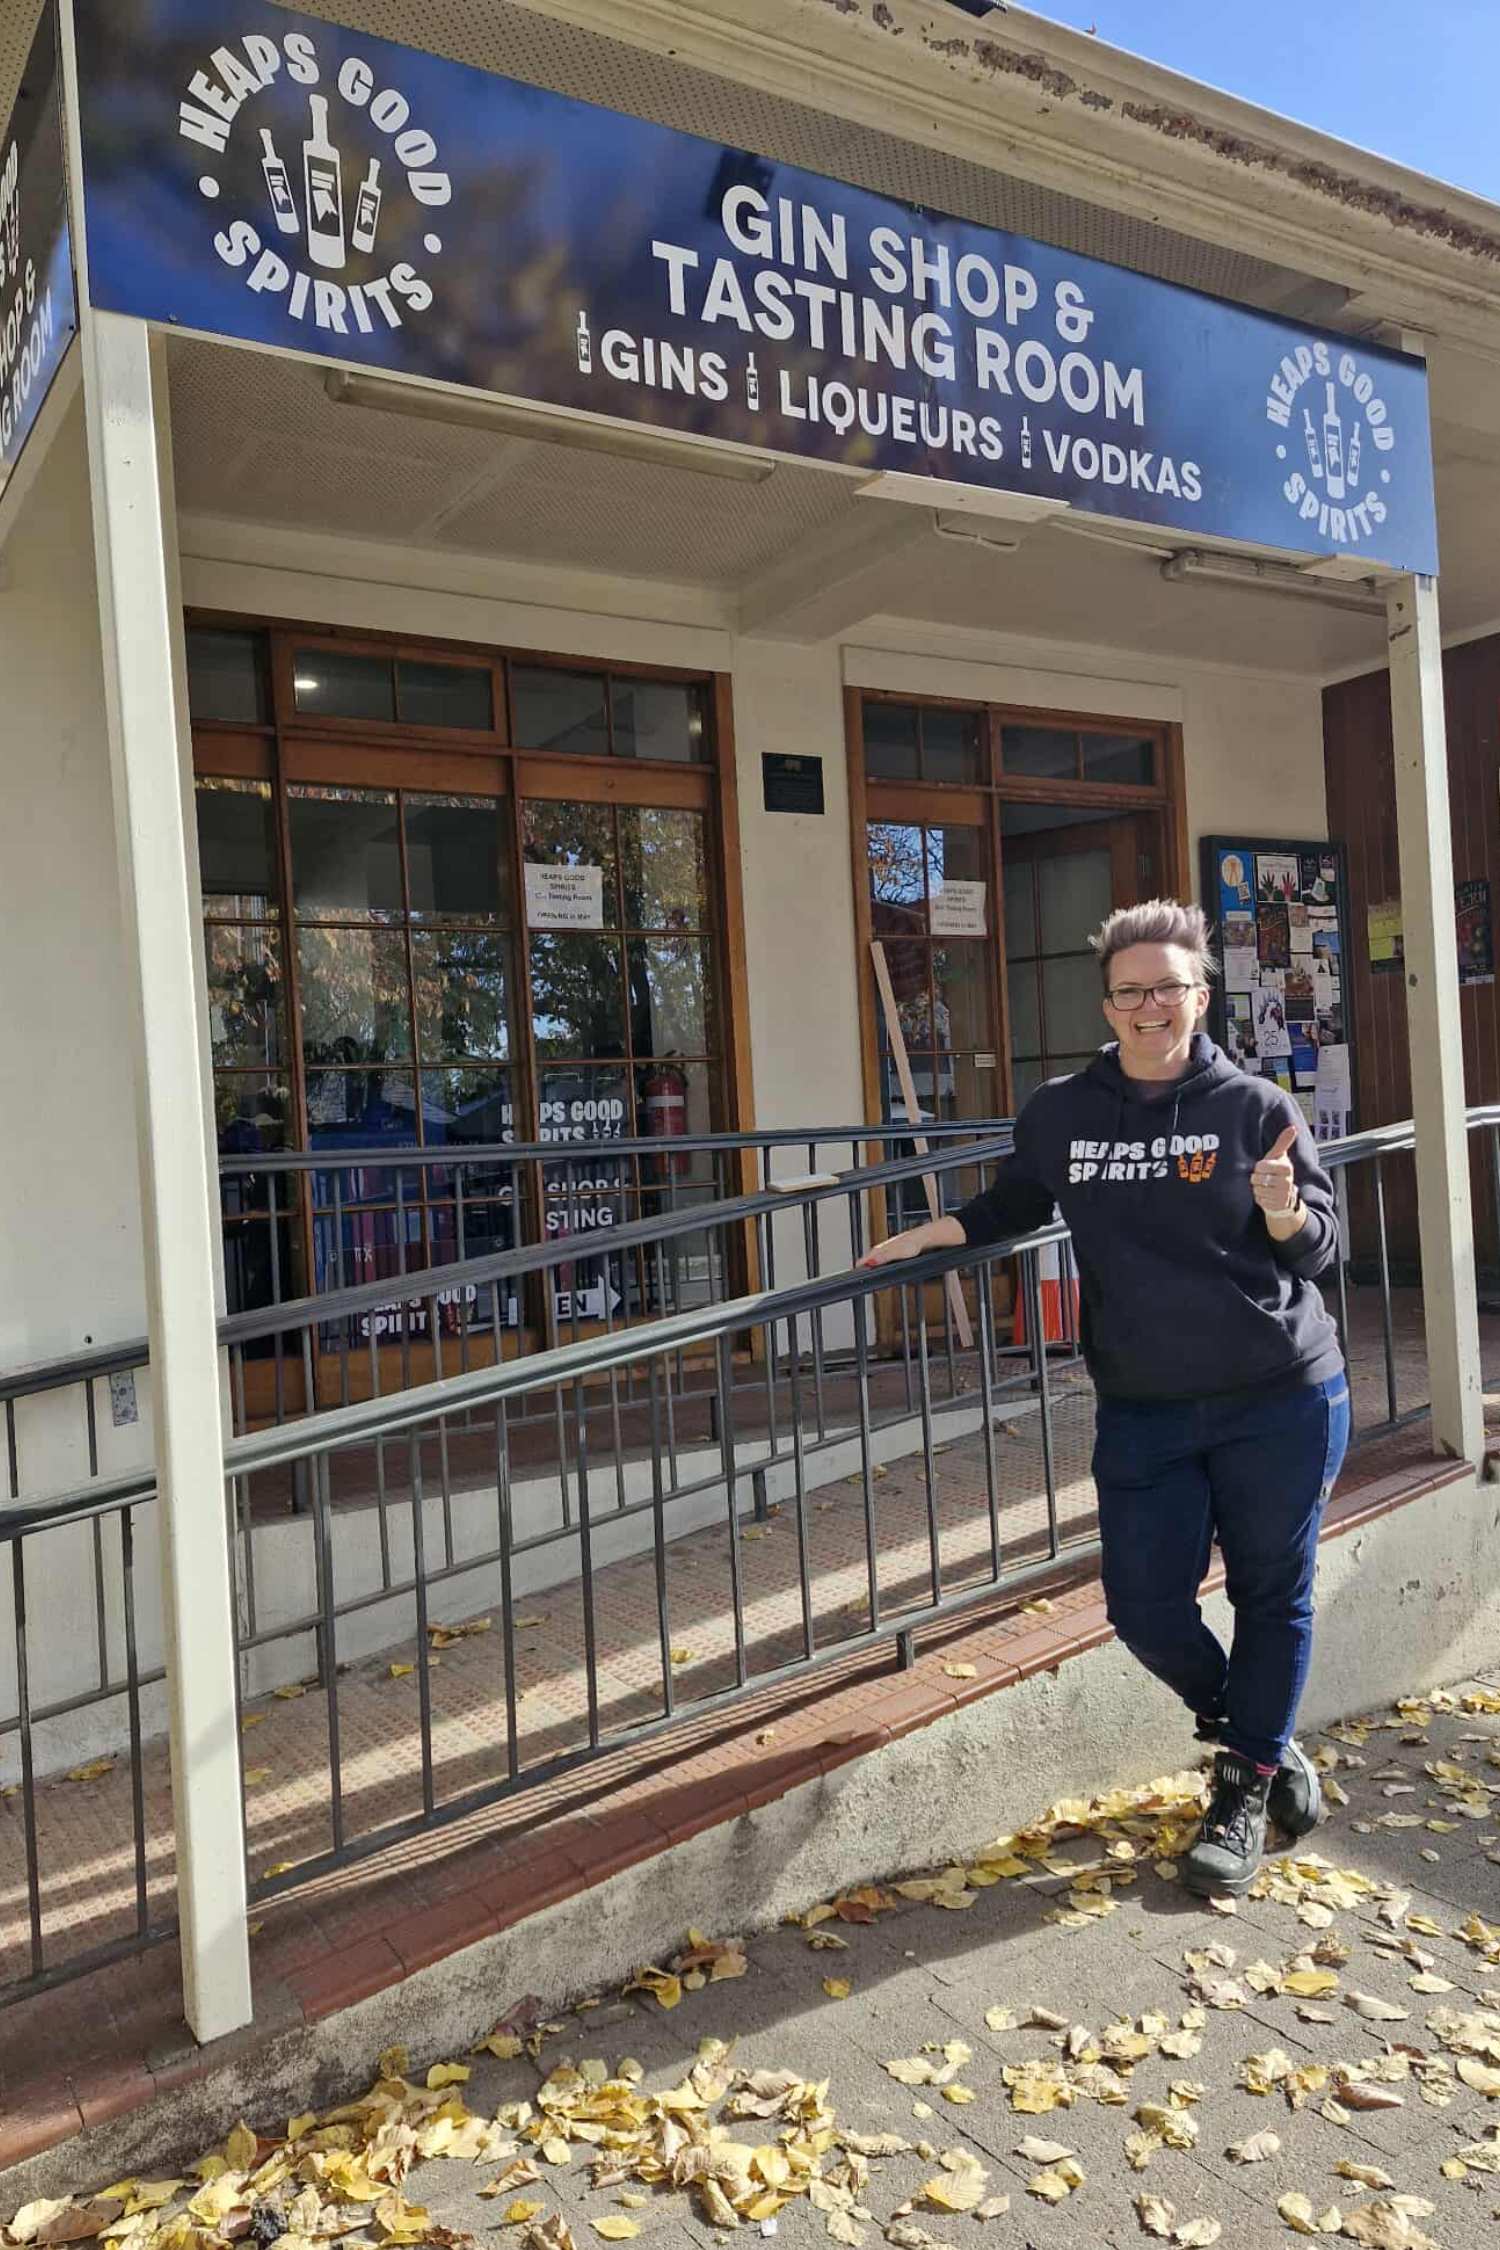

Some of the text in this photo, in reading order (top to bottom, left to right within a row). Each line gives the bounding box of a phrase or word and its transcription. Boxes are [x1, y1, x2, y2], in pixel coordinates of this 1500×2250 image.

[179, 33, 453, 207] HEAPS GOOD
[212, 219, 433, 335] SPIRITS
[720, 184, 1095, 343] GIN SHOP &
[0, 286, 23, 388] HOP
[12, 286, 53, 424] ROOM
[651, 239, 1145, 427] TASTING ROOM
[600, 328, 1203, 503] GINS LIQUEURS VODKAS
[1266, 341, 1395, 451] HEAPS GOOD
[1283, 472, 1387, 543] SPIRITS
[501, 1099, 624, 1124] HPS GOOD
[1069, 1134, 1220, 1161] HEAPS GOOD
[546, 1206, 613, 1231] STING
[1068, 1161, 1169, 1184] SPIRITS
